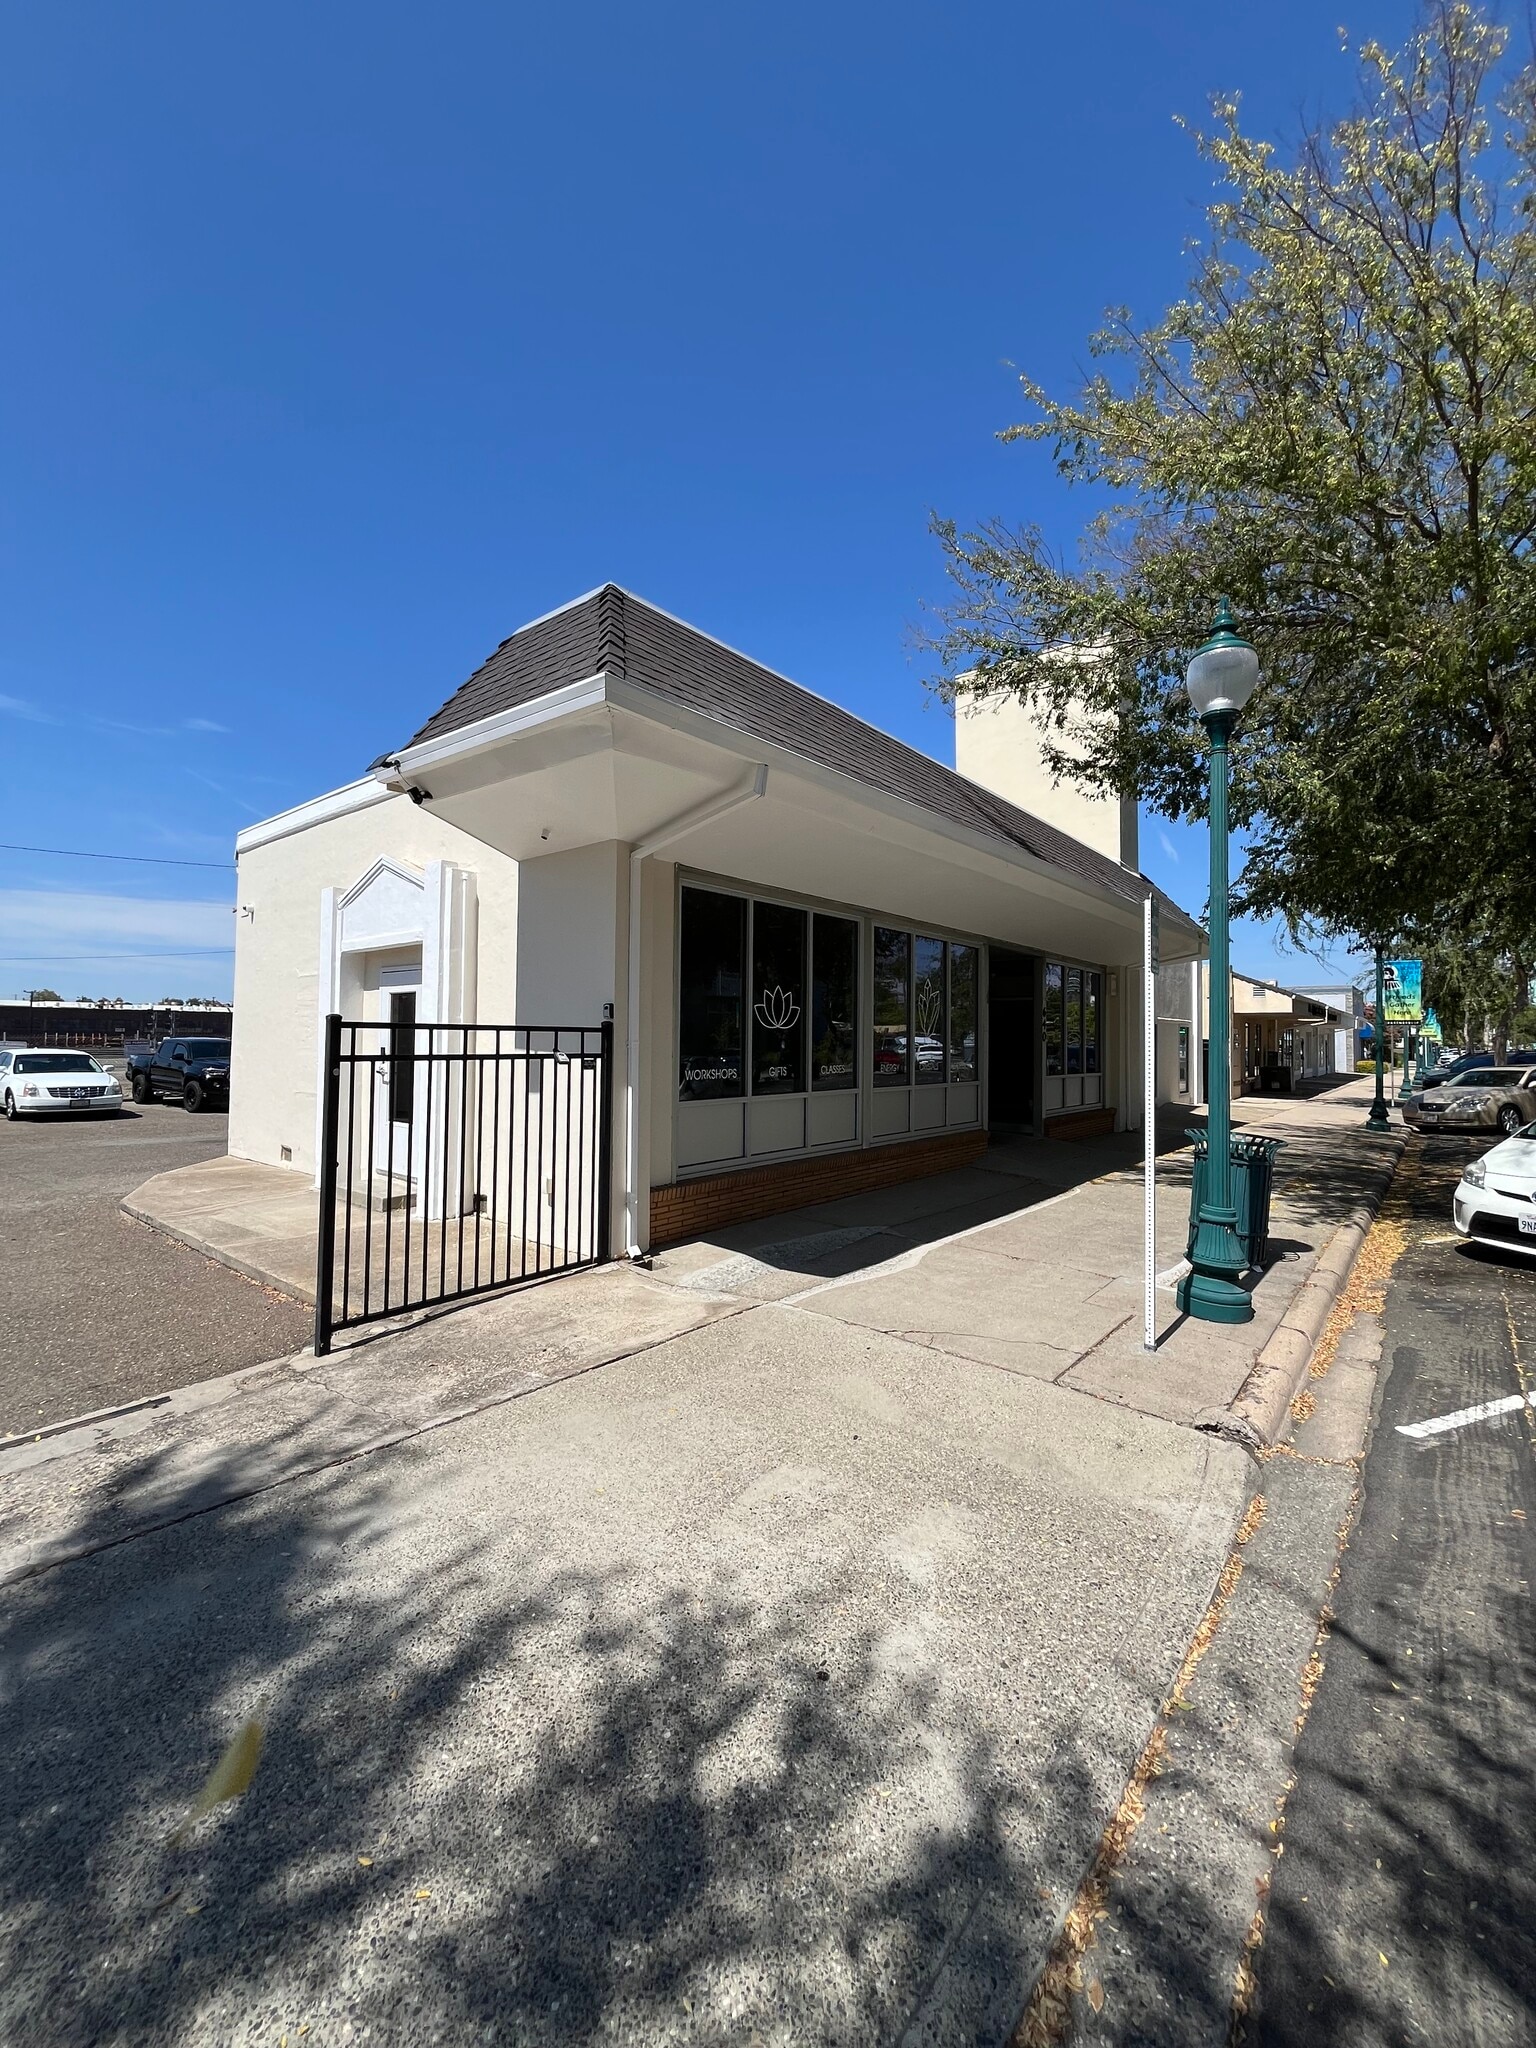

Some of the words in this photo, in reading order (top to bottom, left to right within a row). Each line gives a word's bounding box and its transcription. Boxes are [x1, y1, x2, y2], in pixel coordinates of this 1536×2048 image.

[685, 1069, 737, 1080] WORKSHOPS
[768, 1066, 788, 1077] GIFTS
[820, 1065, 846, 1075] CLASSES
